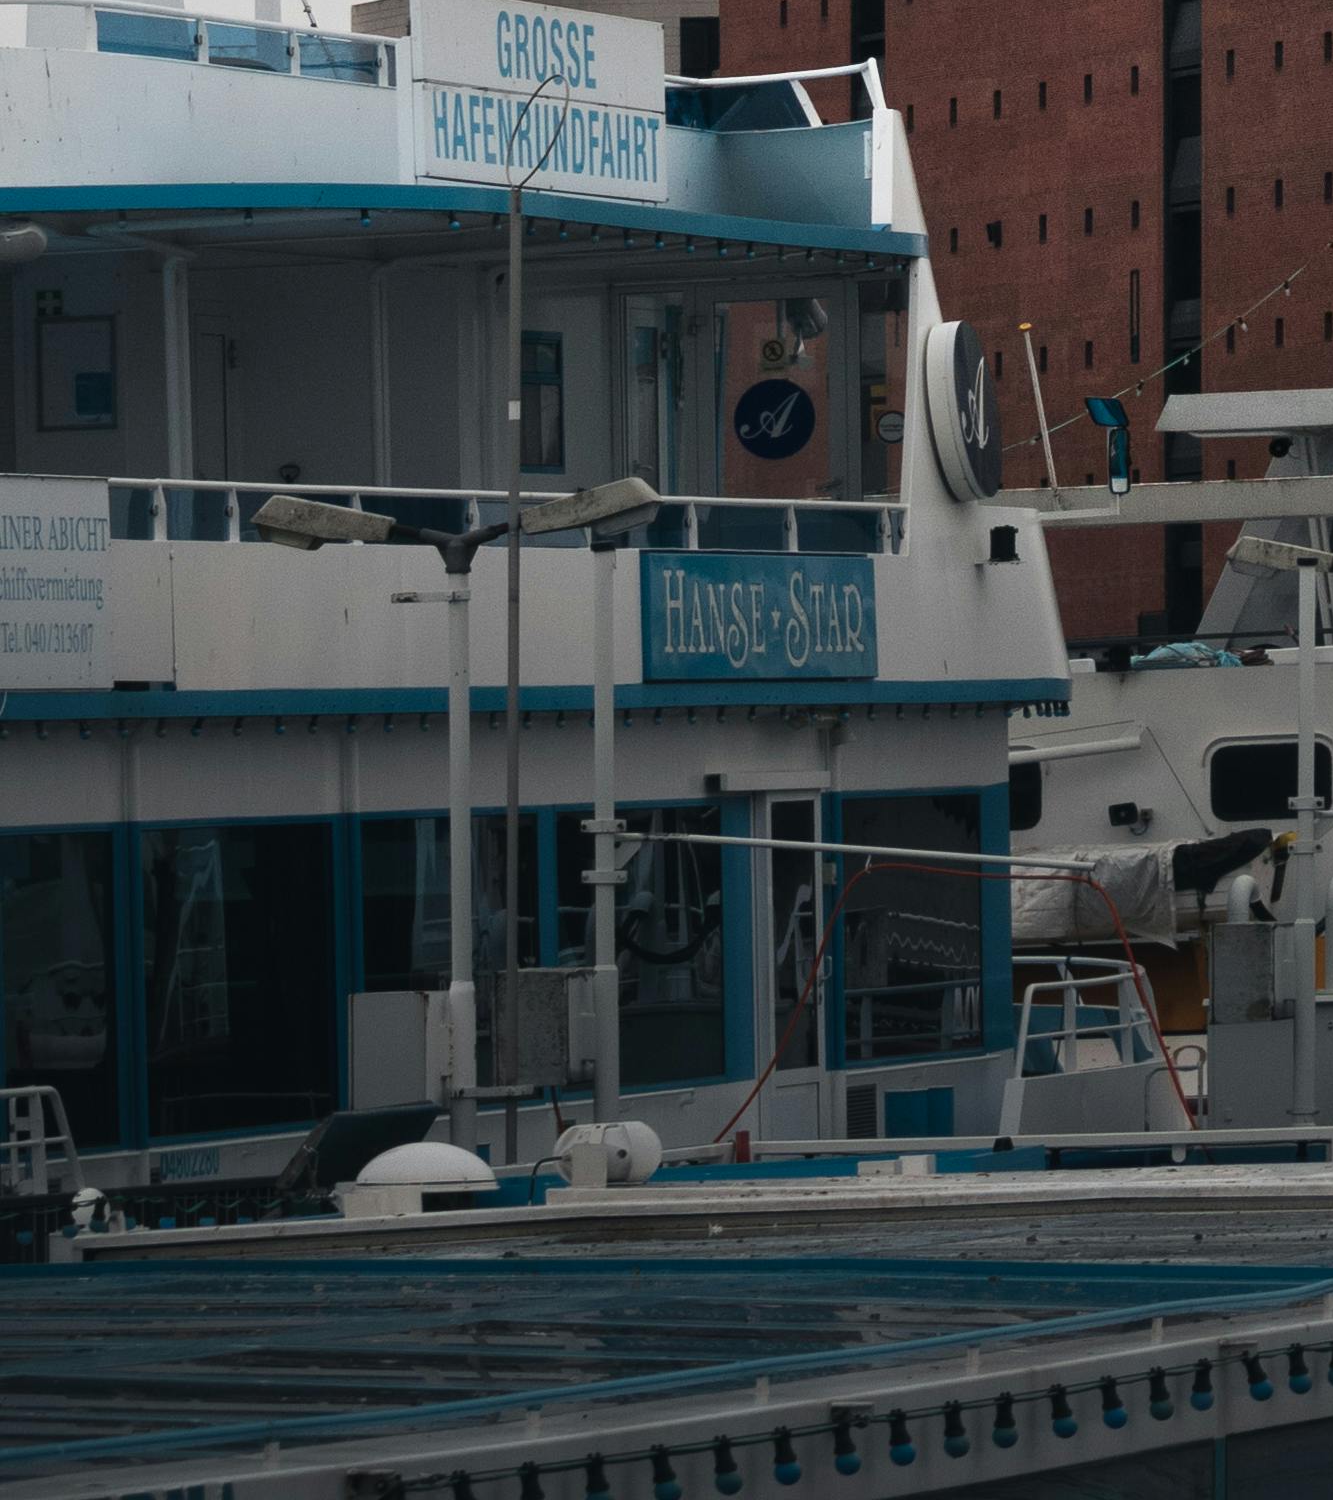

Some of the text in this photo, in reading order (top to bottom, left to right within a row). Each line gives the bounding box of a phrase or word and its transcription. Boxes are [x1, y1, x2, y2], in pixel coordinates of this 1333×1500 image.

[496, 10, 597, 89] GROSSE
[432, 90, 660, 183] HAFENRUNDFAHRT
[0, 515, 108, 551] INER ABICHT
[1, 621, 22, 652] Tel.
